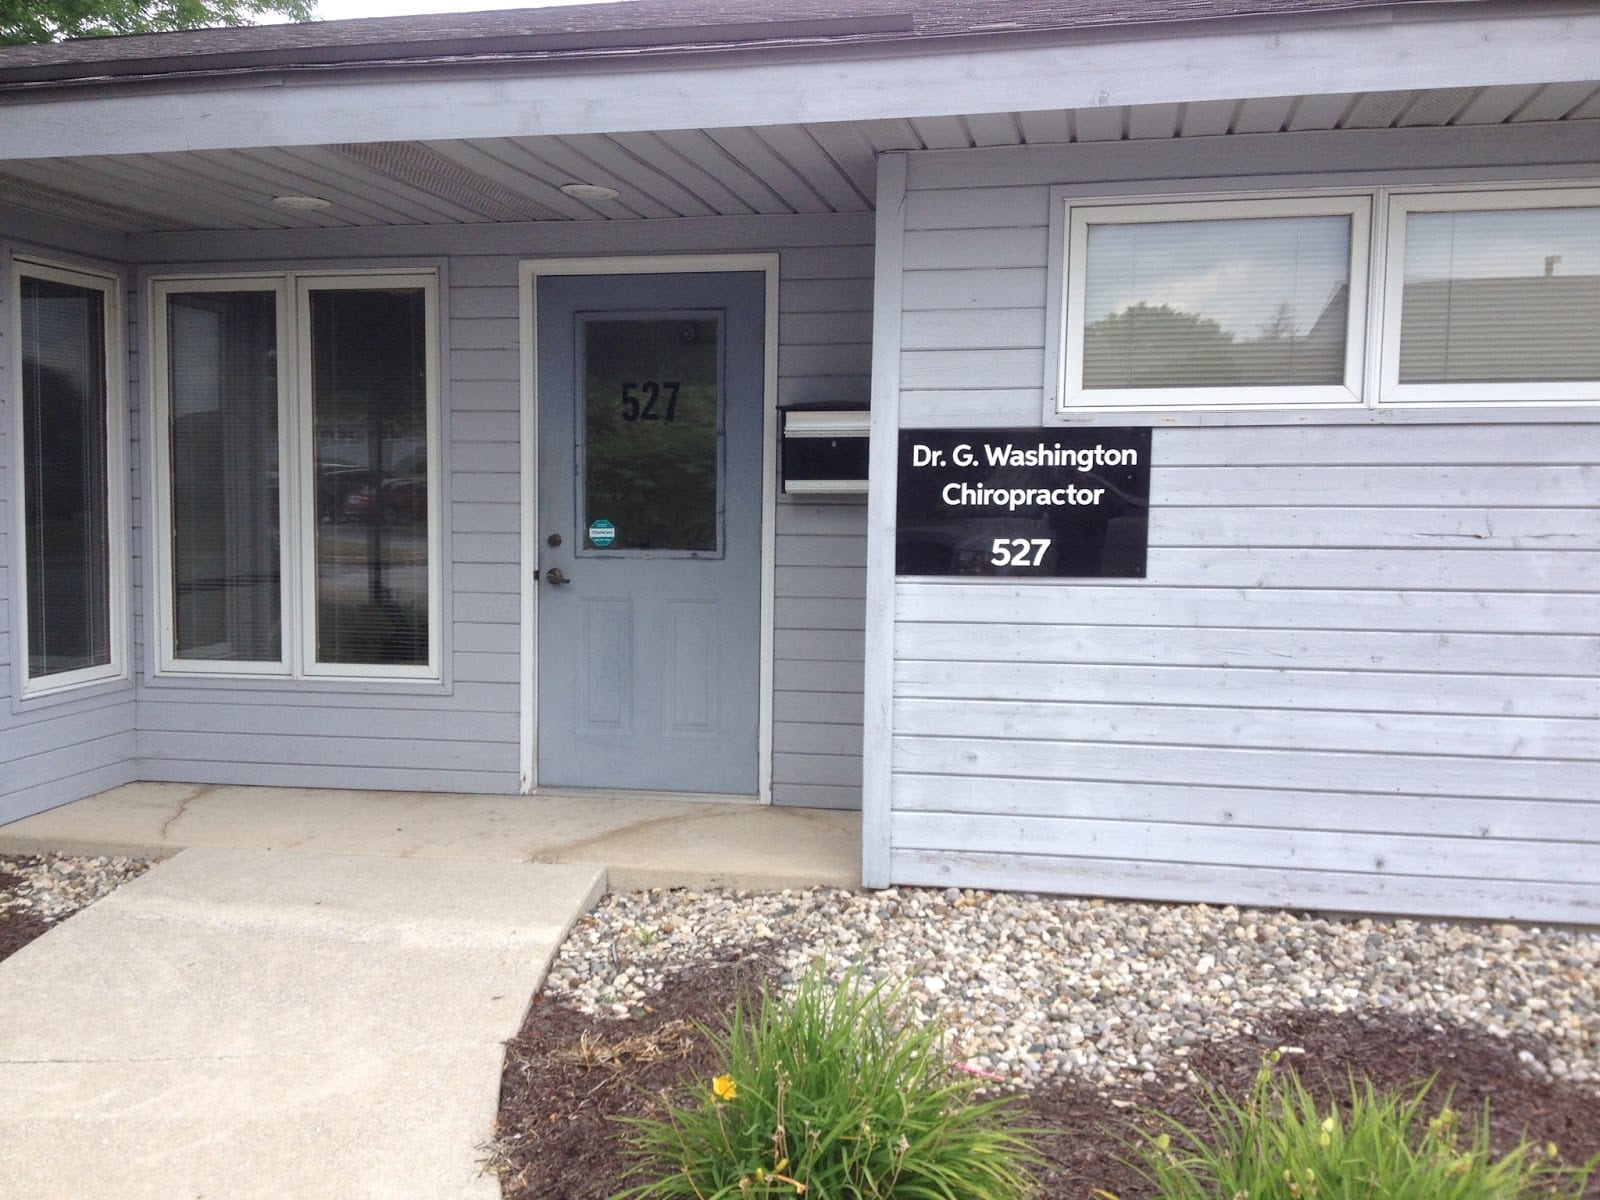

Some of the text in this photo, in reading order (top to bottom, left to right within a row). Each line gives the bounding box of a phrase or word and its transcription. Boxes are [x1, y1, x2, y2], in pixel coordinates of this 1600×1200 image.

[621, 380, 681, 422] 527
[912, 443, 1137, 472] Dr. G. Washington
[942, 482, 1105, 511] Chiropractor
[990, 538, 1051, 566] 527
